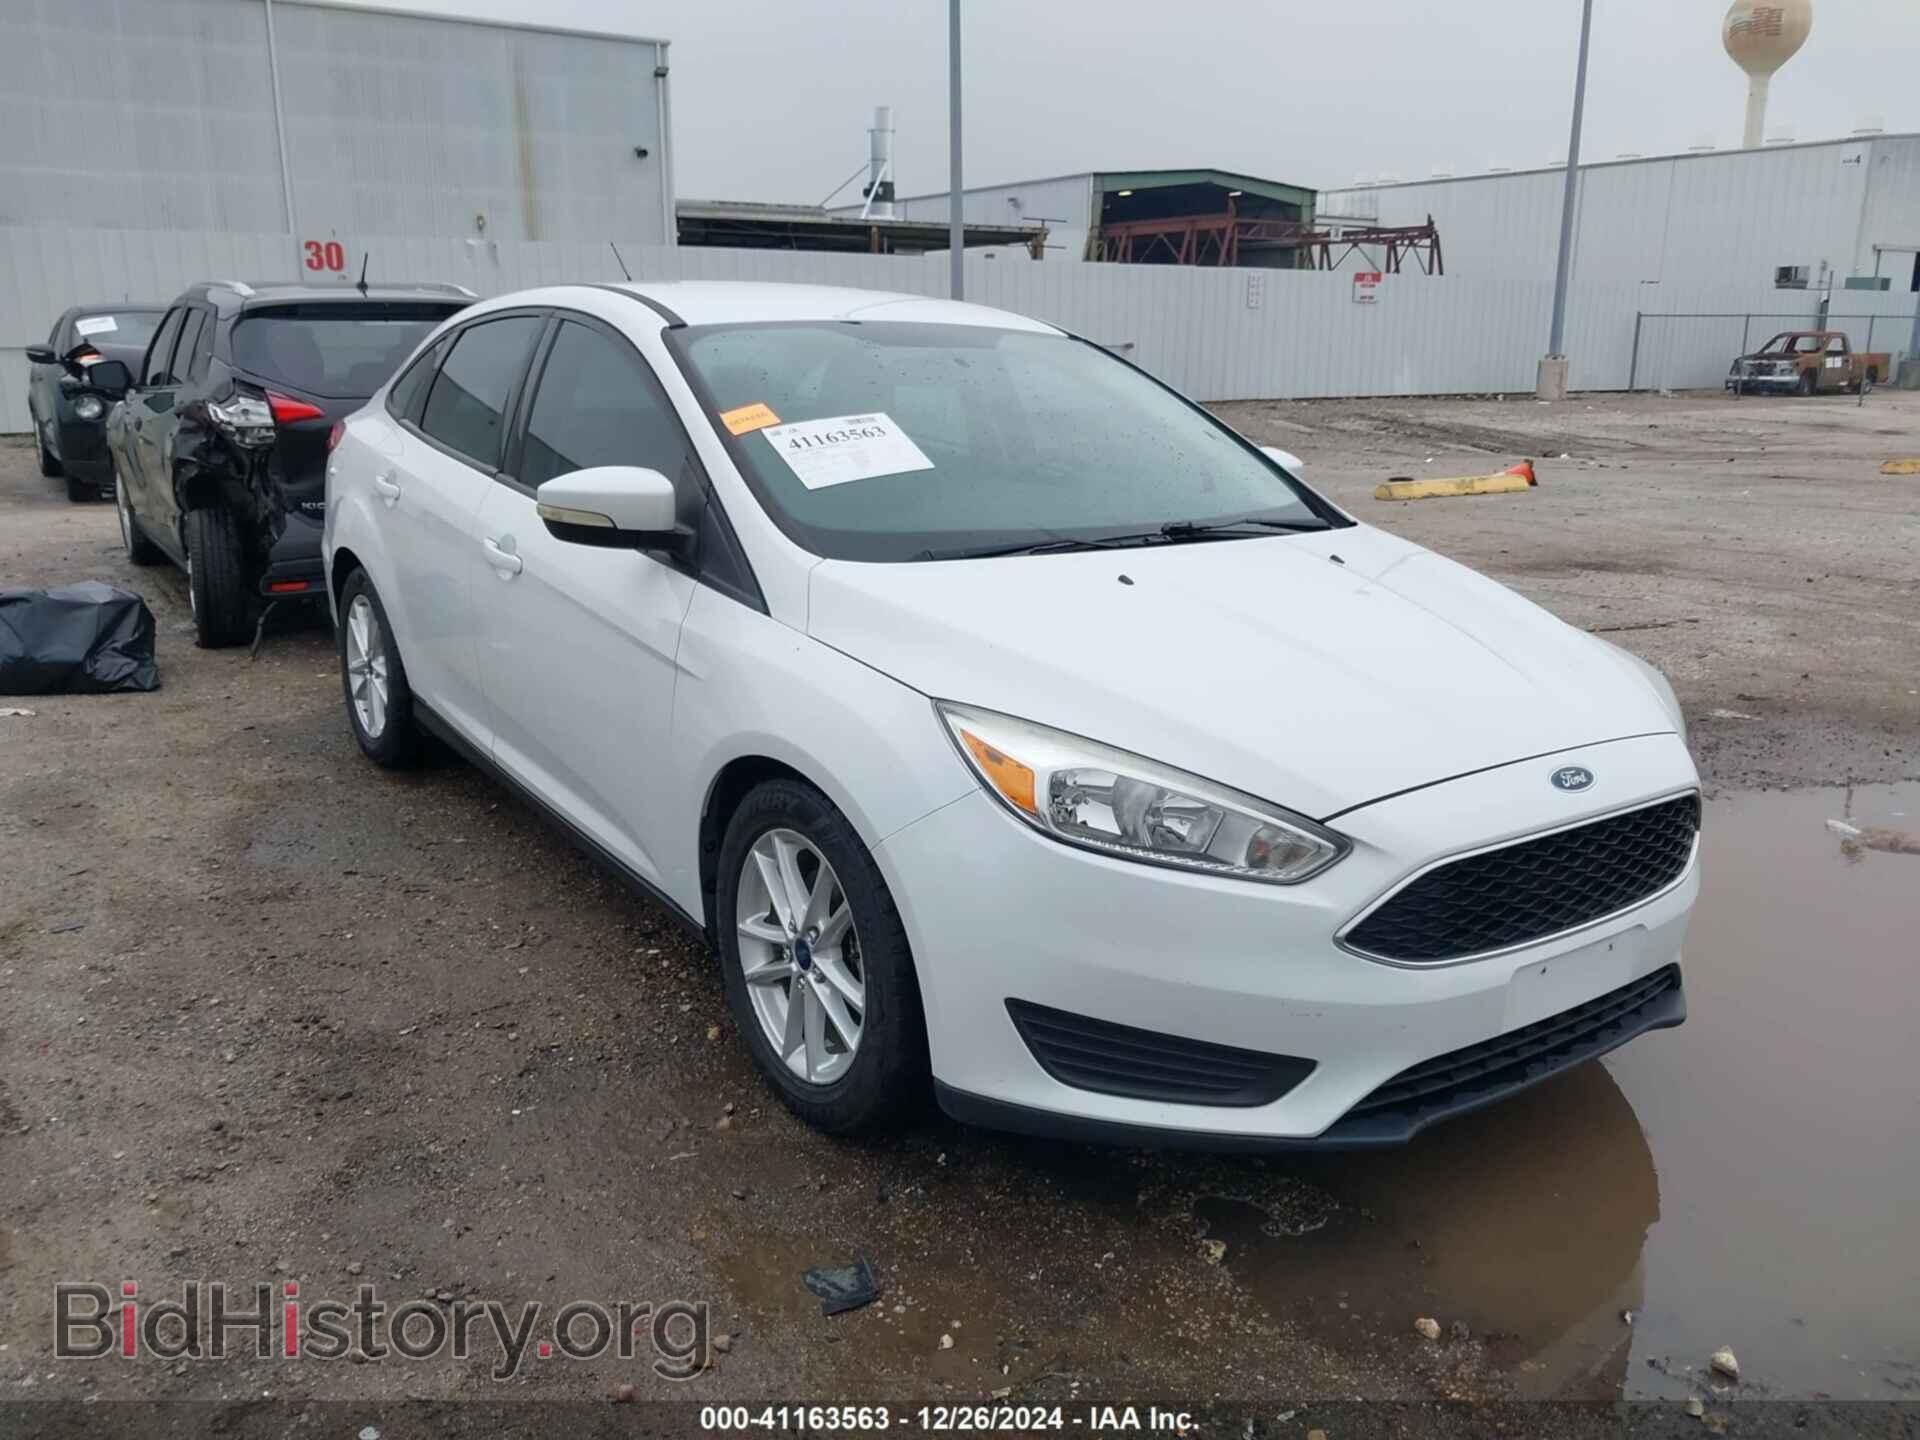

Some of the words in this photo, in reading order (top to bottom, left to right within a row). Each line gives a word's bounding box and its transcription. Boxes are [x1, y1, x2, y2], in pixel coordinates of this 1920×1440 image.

[304, 240, 345, 272] 30
[788, 425, 887, 450] 41163563
[1560, 769, 1587, 788] Ford
